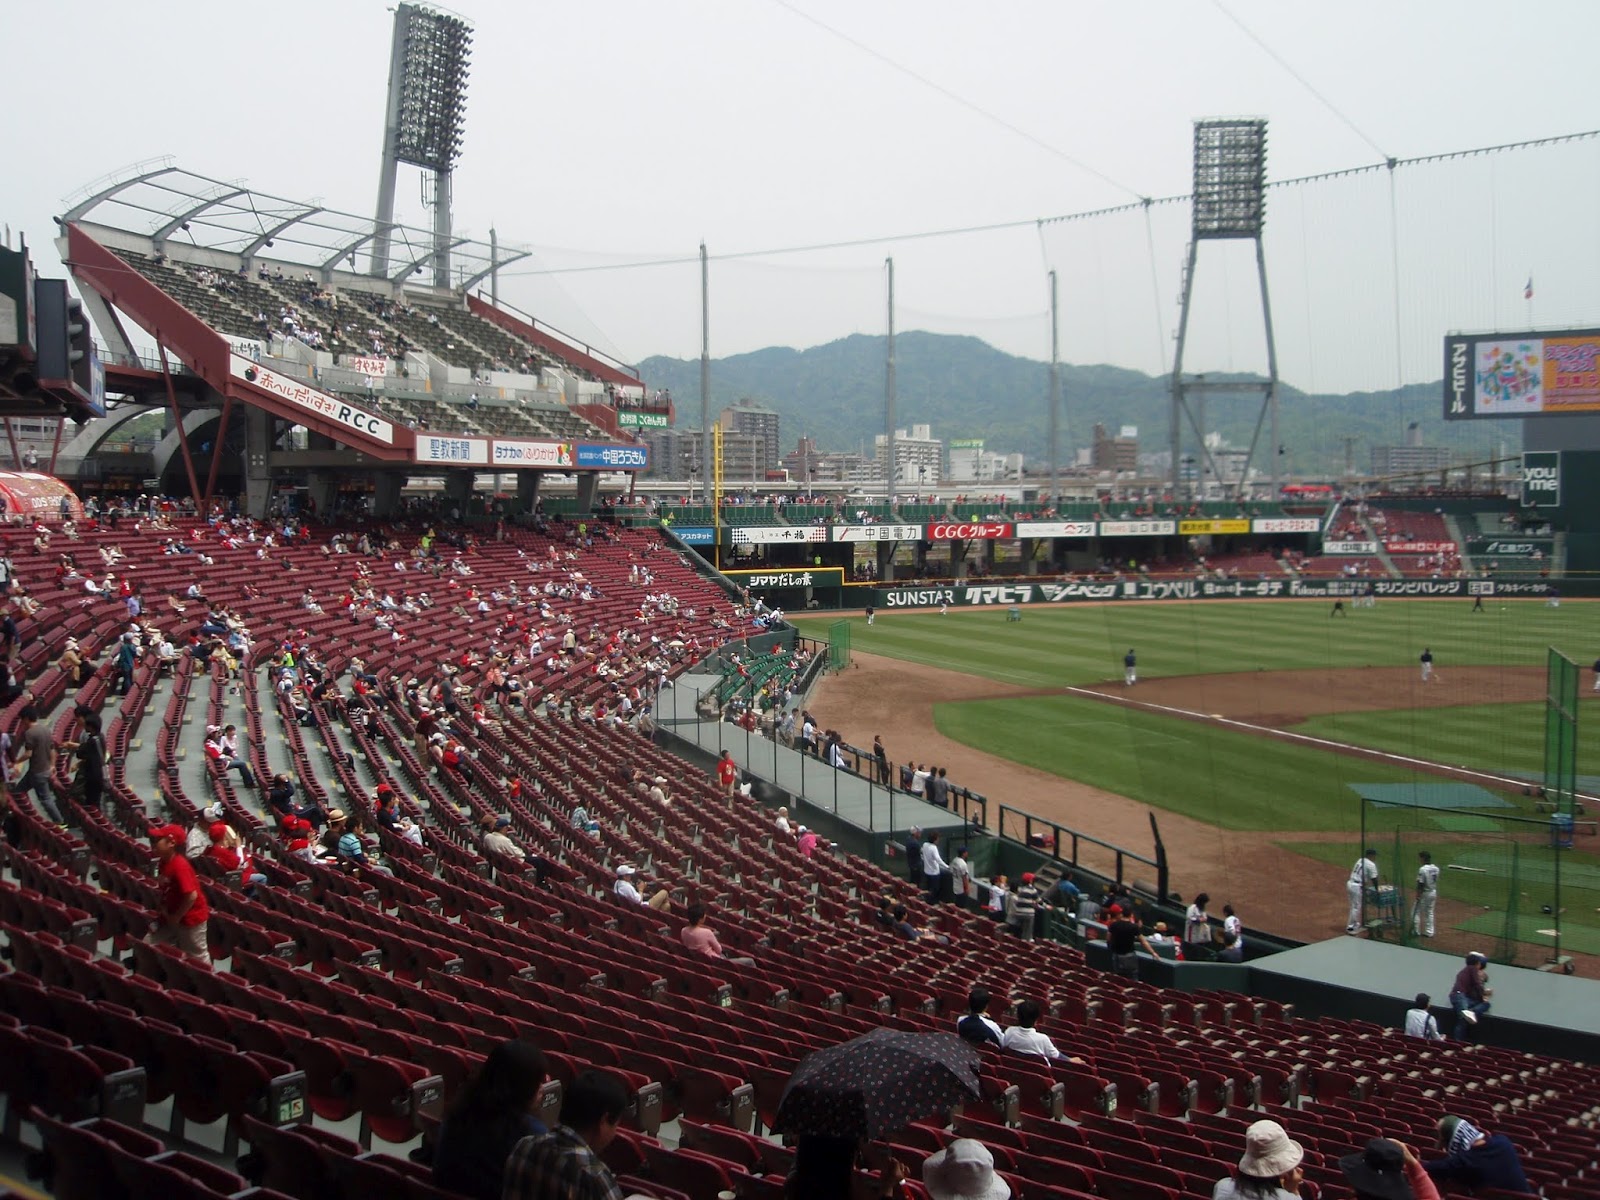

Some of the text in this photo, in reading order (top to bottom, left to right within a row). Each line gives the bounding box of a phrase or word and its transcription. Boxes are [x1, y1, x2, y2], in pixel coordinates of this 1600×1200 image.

[1451, 343, 1468, 414] アサヒビール
[338, 405, 380, 434] RCC
[430, 438, 470, 460] 聖教新聞
[602, 448, 646, 465] 中国ろうきん
[1524, 467, 1556, 482] you
[1530, 476, 1558, 490] me
[680, 533, 713, 541] アスカネット
[865, 526, 917, 540] 中国電力
[750, 572, 813, 587] シマヤだしの素
[965, 586, 1032, 604] クマヒラ
[1375, 582, 1460, 593] キリンビバレッジ
[886, 590, 954, 606] SUNSTAR
